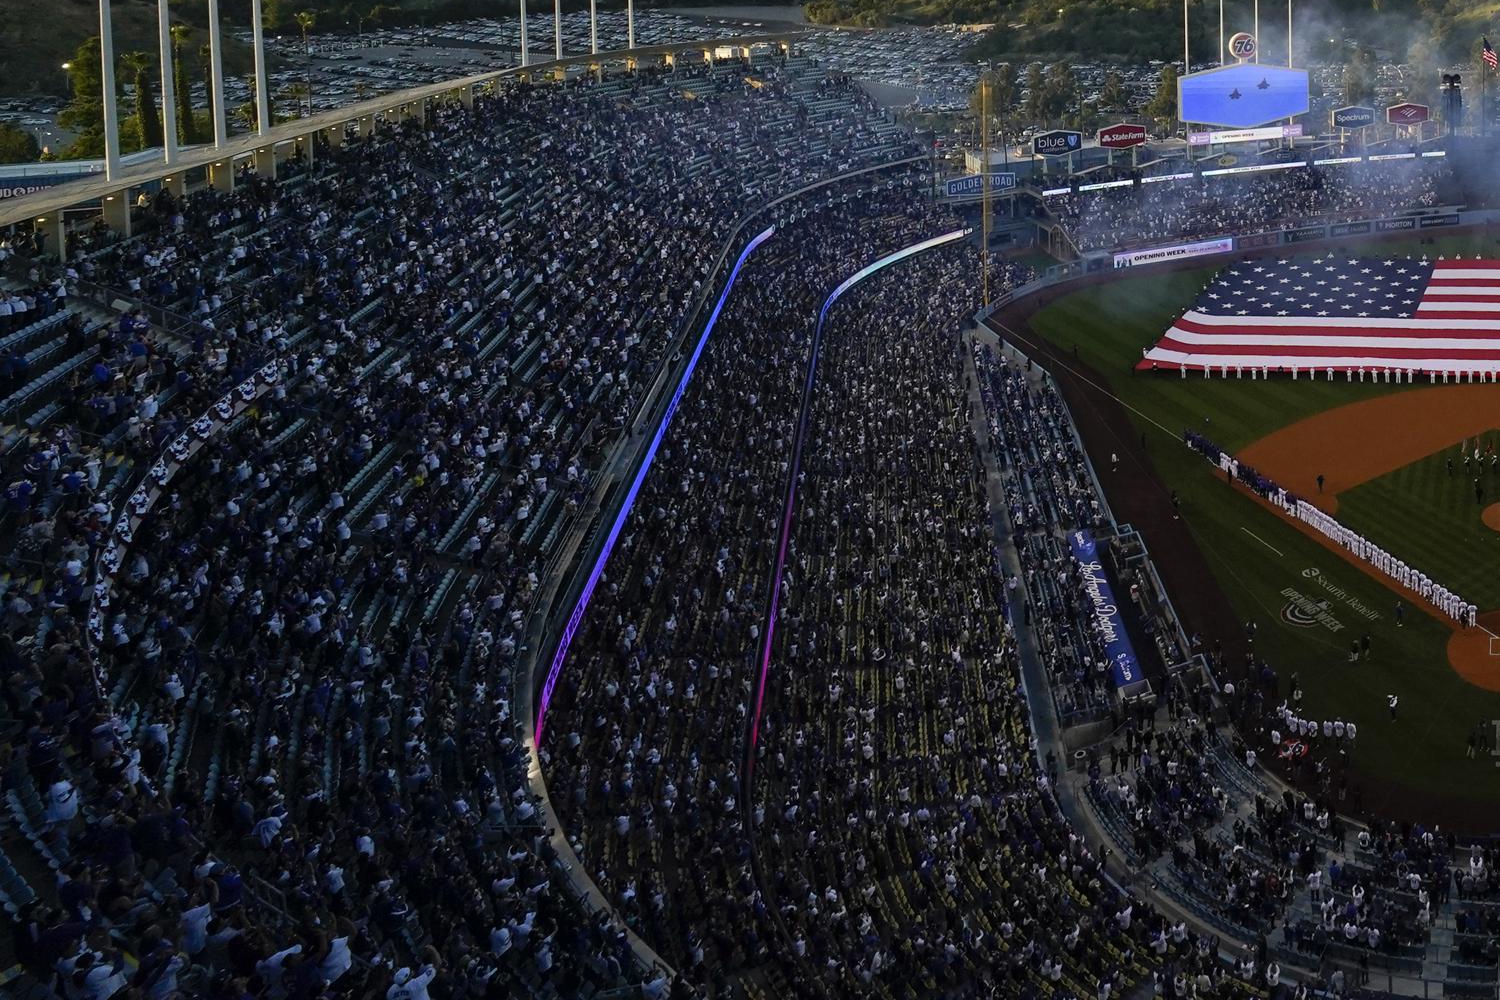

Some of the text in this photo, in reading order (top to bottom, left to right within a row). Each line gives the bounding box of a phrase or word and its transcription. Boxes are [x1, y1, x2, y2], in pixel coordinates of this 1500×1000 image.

[1235, 37, 1255, 54] 76
[1336, 113, 1370, 123] Spectrum
[1038, 136, 1065, 148] blue
[989, 176, 1012, 186] ROAD
[1385, 220, 1413, 229] MORTON
[1134, 252, 1166, 262] OPENING
[1166, 248, 1186, 257] WEEK
[1280, 587, 1345, 633] OPENING WEEK
[1096, 604, 1118, 643] Dodgers
